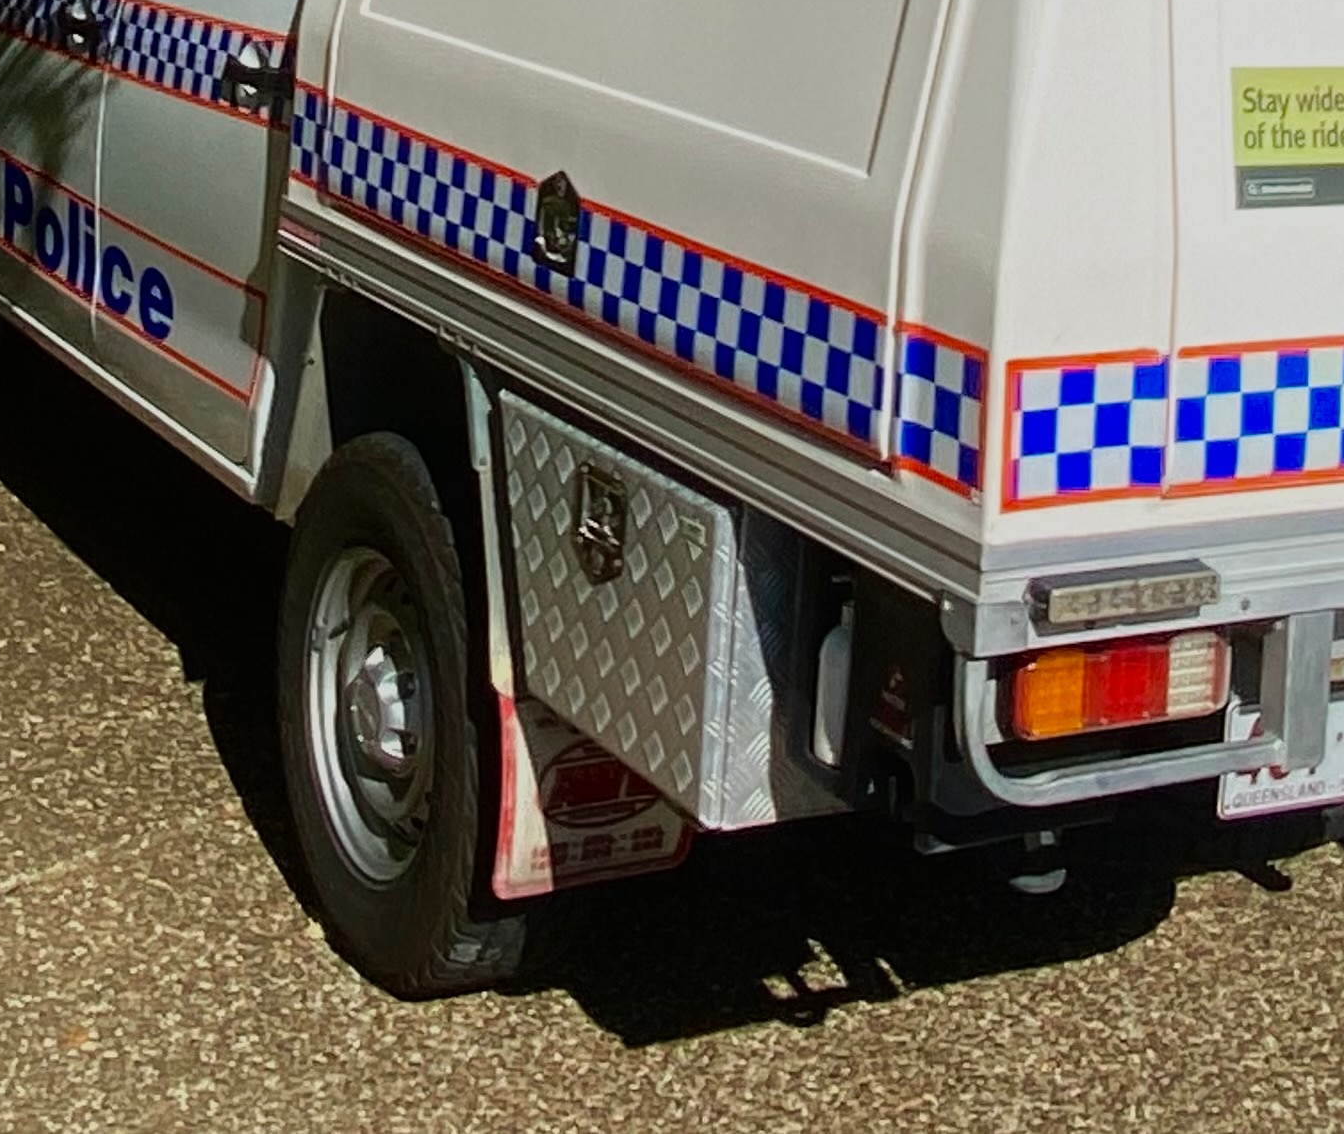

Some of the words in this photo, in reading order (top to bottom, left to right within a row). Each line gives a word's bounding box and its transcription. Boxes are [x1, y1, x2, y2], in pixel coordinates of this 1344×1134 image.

[1242, 87, 1290, 118] Stay
[1244, 122, 1266, 149] of
[1272, 123, 1306, 149] the
[4, 160, 173, 343] Police
[1232, 780, 1325, 808] QUEENSLAND
